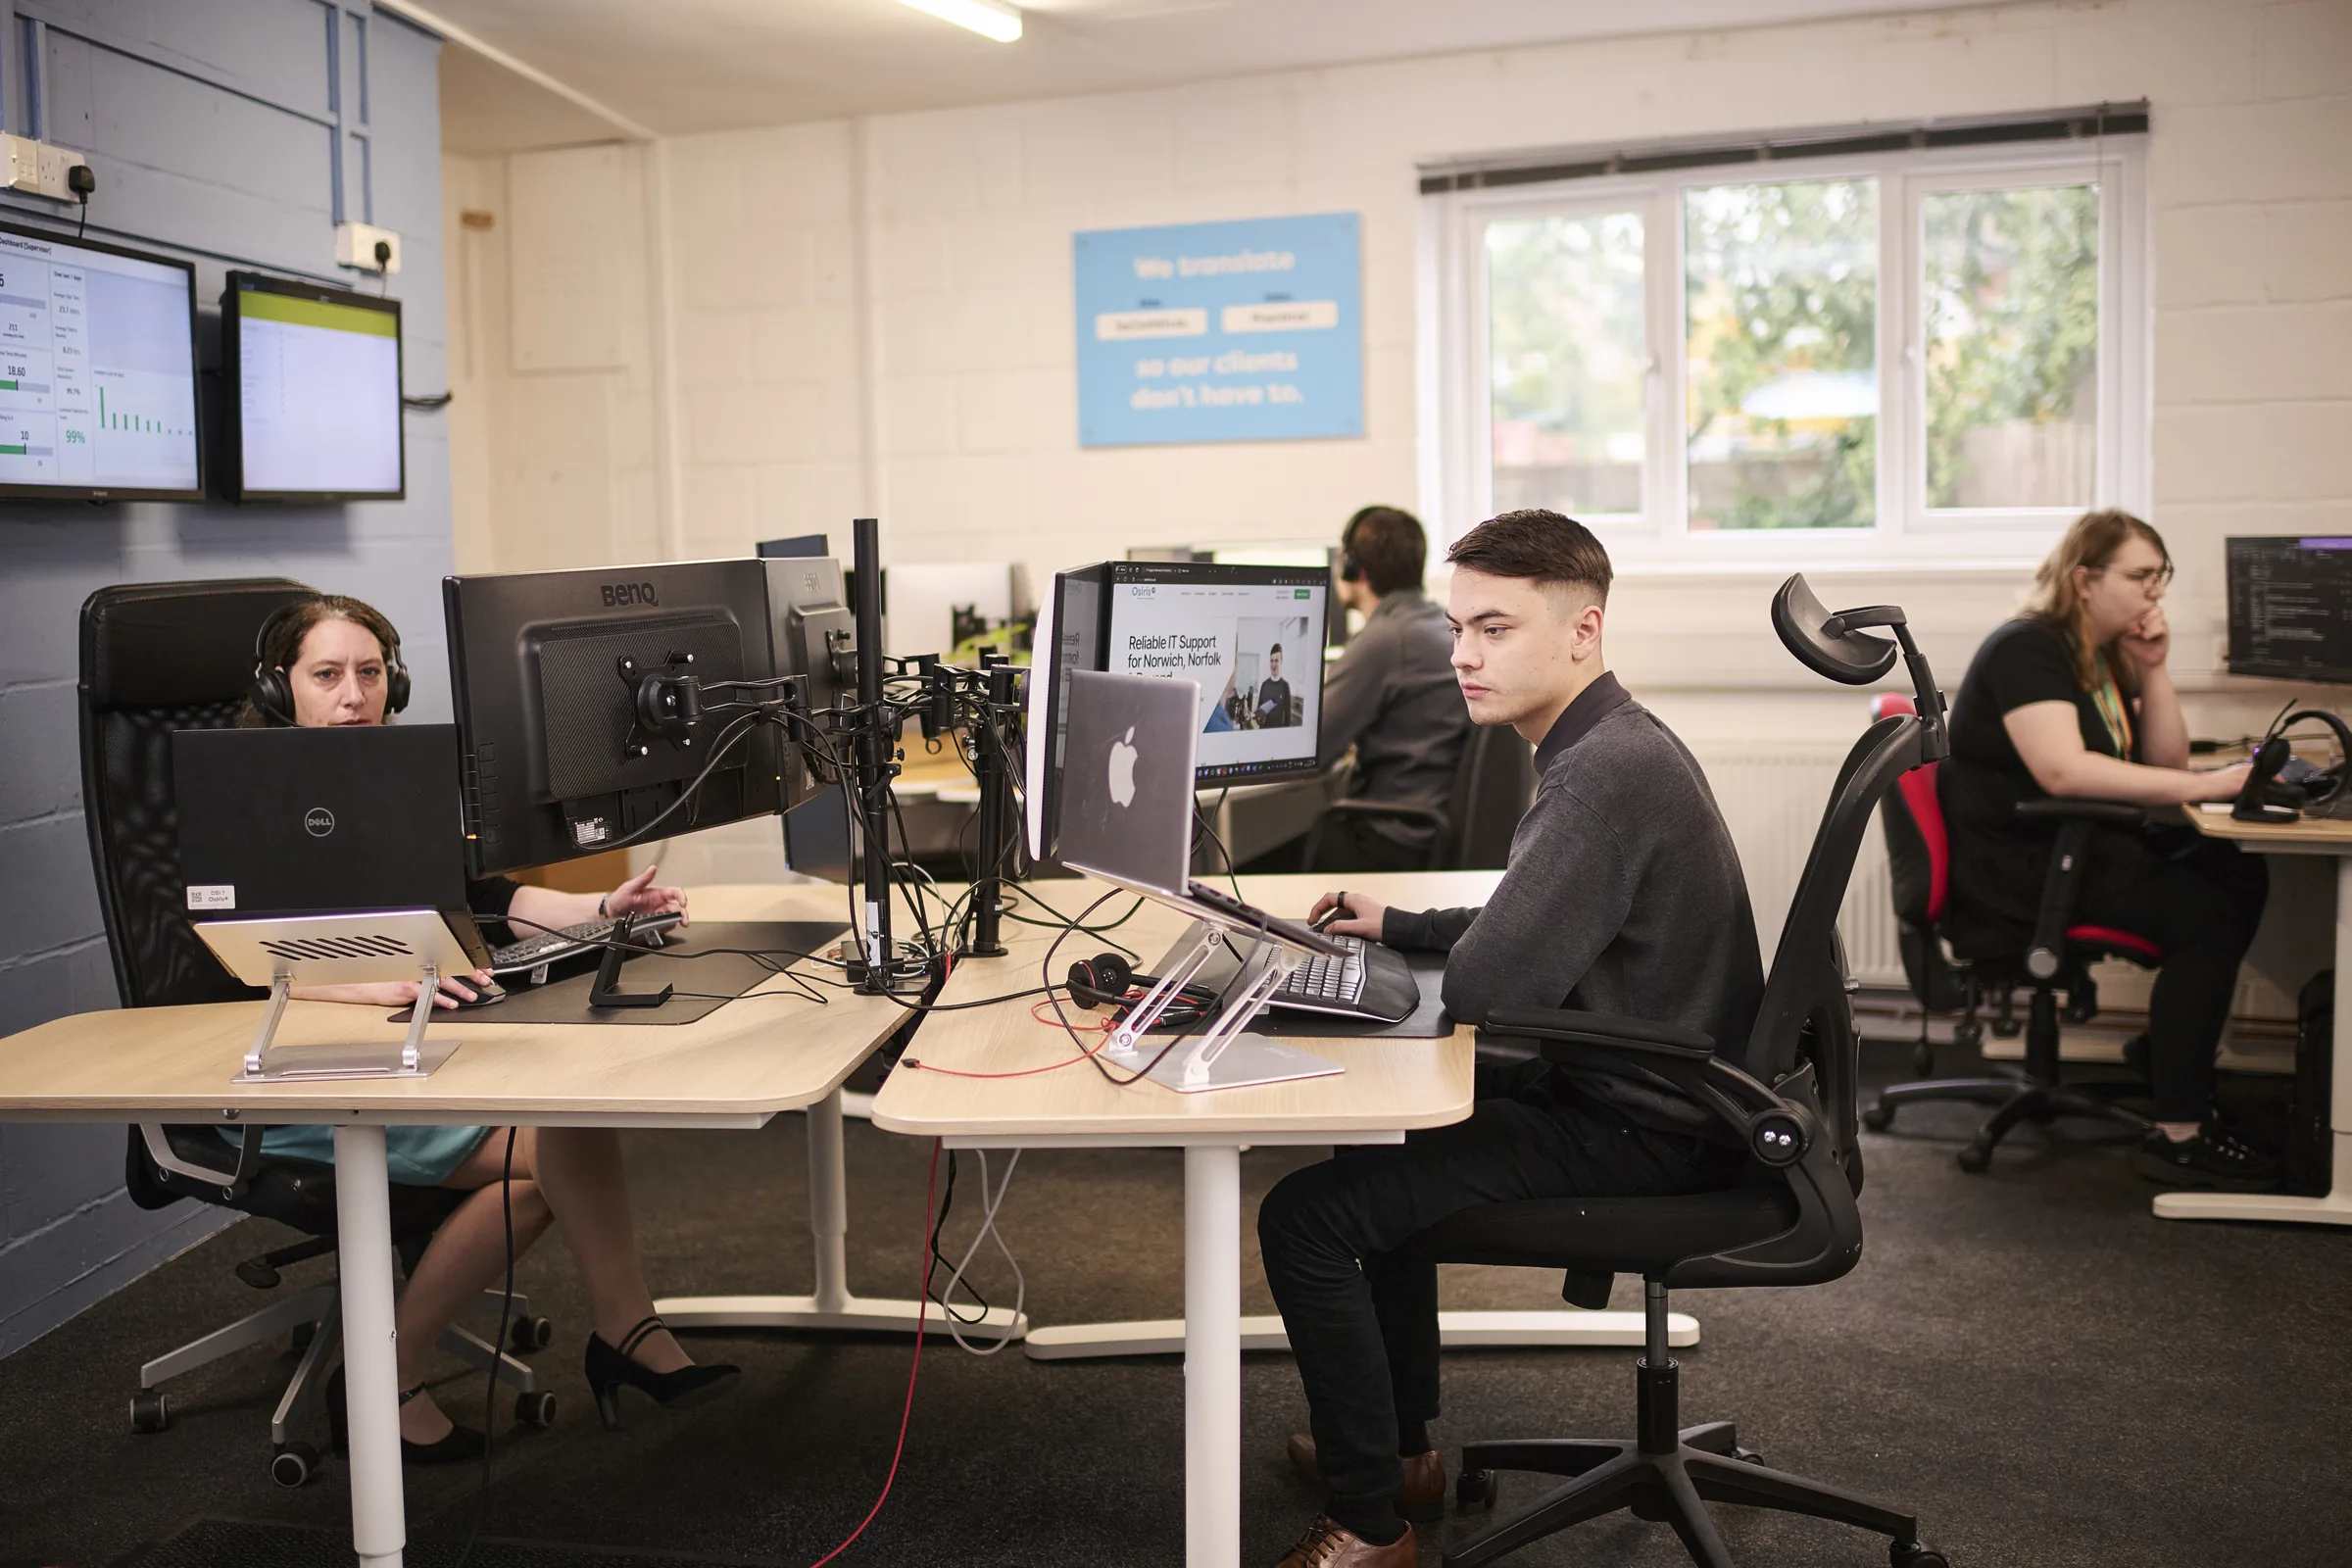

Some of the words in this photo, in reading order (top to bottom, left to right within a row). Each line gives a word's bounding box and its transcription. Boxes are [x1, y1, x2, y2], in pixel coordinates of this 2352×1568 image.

[8, 365, 25, 377] 18.60
[1168, 357, 1210, 377] our
[1213, 349, 1299, 375] clients
[1130, 384, 1197, 410] don't
[1199, 382, 1264, 407] have
[1267, 382, 1305, 404] to.
[21, 430, 29, 441] 10
[66, 429, 85, 444] 99%
[601, 582, 660, 608] BenQ
[1132, 586, 1152, 597] Osiris
[1129, 635, 1167, 650] Reliable
[1168, 634, 1178, 649] IT
[1179, 634, 1217, 652] Support
[1128, 654, 1142, 668] for
[1144, 653, 1186, 669] Norwich,
[1188, 652, 1222, 666] Norfolk
[308, 817, 332, 826] DELL
